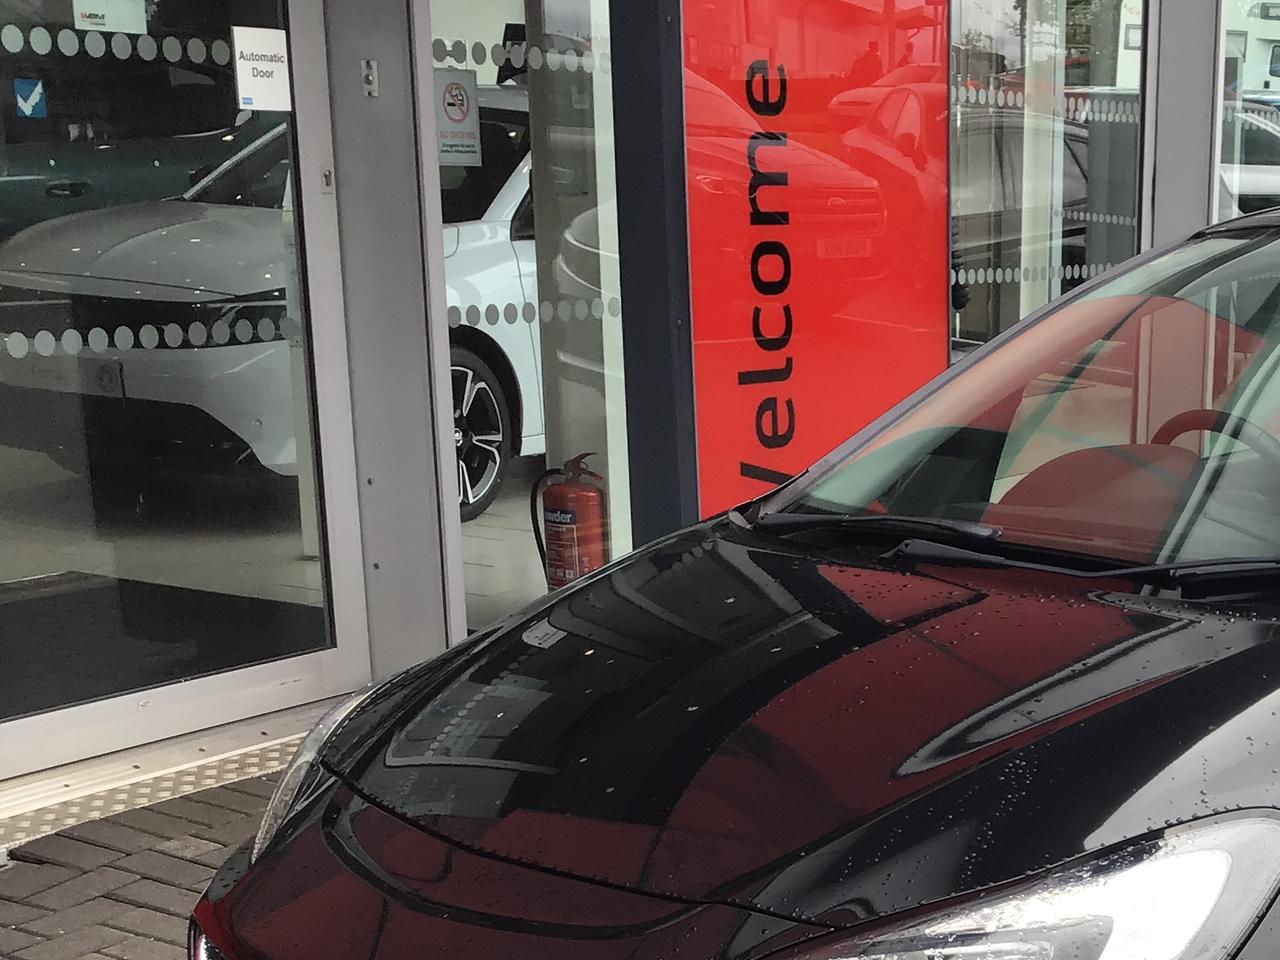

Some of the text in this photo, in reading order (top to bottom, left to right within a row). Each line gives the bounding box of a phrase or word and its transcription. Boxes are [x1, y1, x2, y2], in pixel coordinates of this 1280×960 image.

[238, 50, 285, 63] Automatic
[251, 67, 275, 78] Door
[737, 58, 798, 488] elcome
